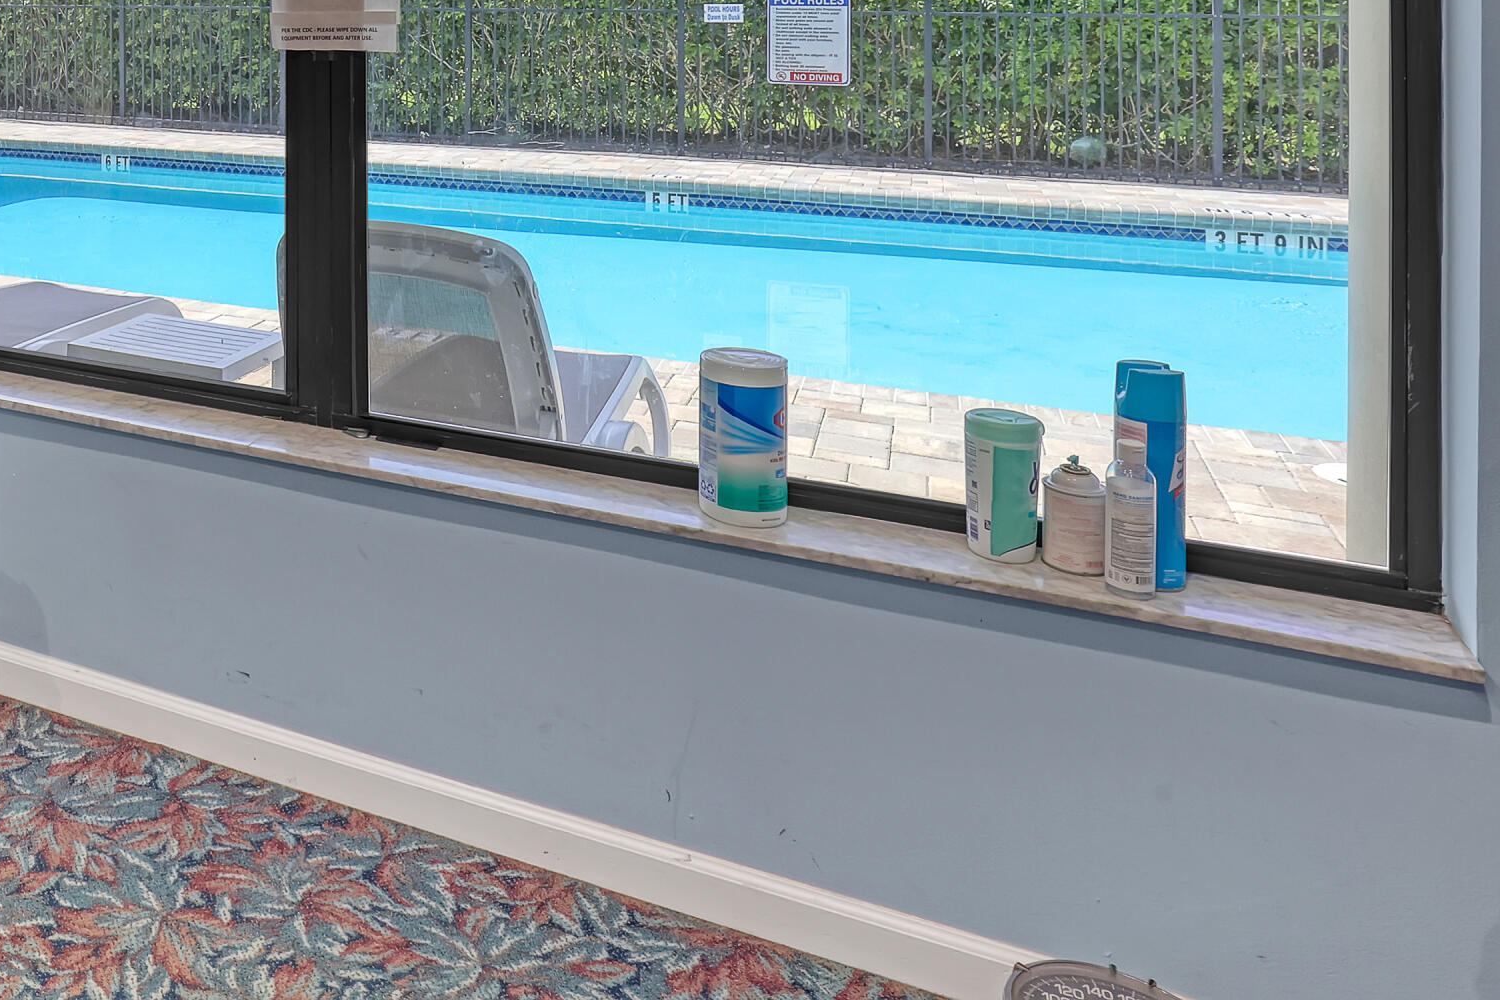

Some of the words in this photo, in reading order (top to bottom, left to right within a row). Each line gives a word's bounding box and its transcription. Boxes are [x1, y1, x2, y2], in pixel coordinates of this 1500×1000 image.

[1237, 232, 1263, 246] FT
[1300, 236, 1323, 250] IN
[1054, 984, 1085, 1000] 120
[1082, 984, 1114, 1000] 140
